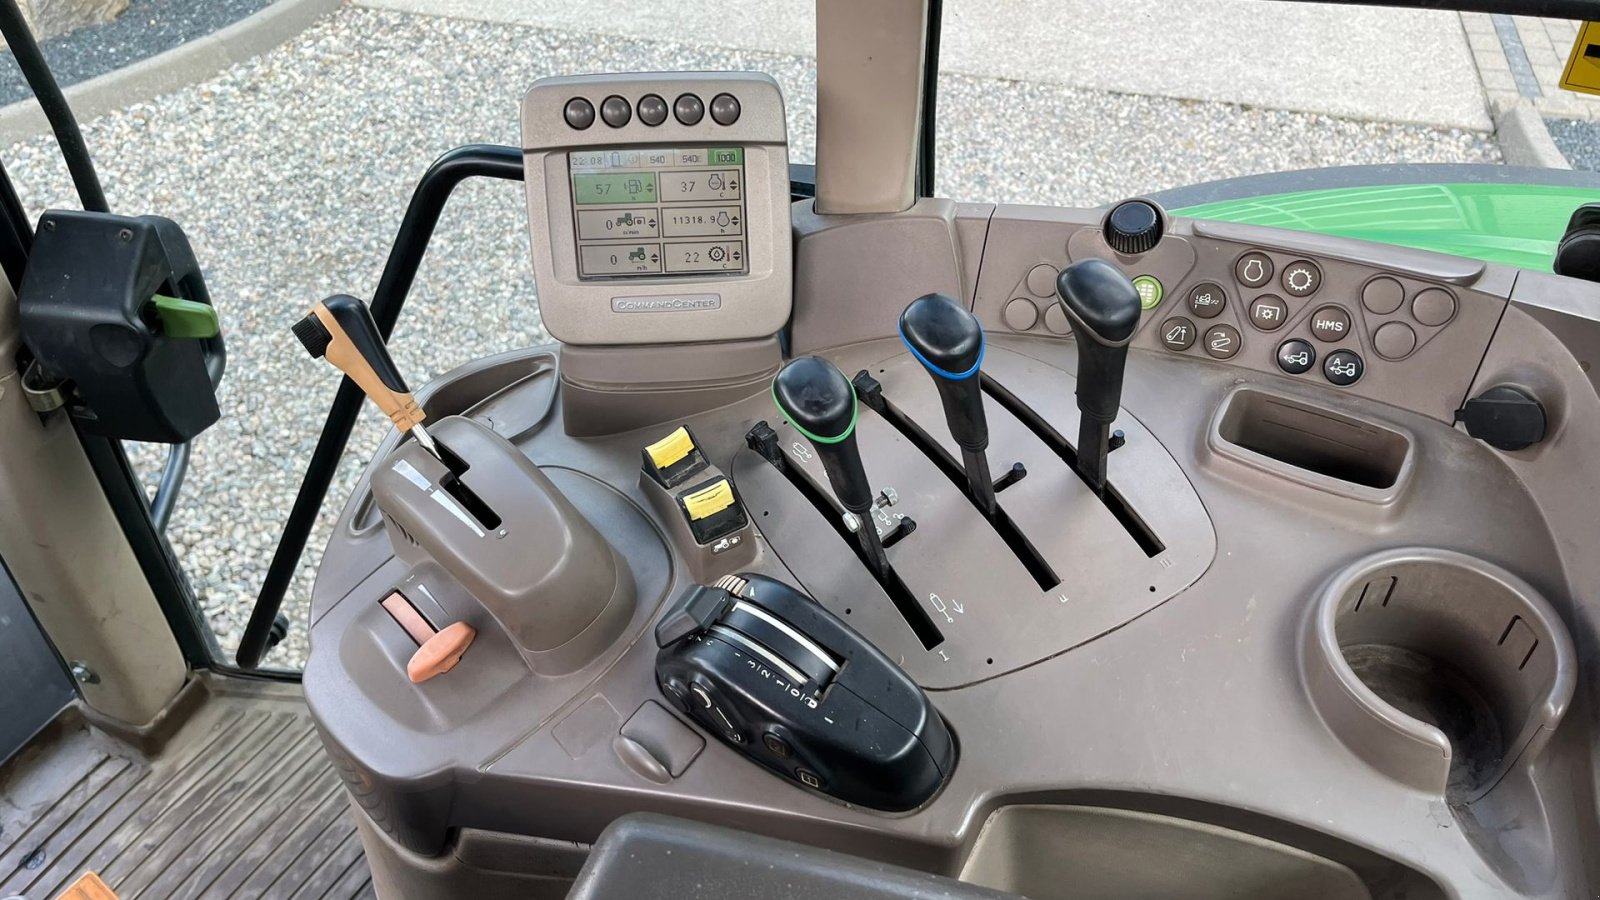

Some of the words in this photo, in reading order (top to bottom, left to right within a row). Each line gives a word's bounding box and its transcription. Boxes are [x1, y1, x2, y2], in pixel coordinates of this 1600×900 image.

[649, 155, 665, 164] 540
[595, 183, 612, 195] 57
[680, 181, 696, 193] 37
[605, 219, 613, 231] 0
[673, 215, 716, 225] 11318.9
[610, 254, 618, 266] 0
[684, 251, 700, 263] 22
[1316, 319, 1344, 332] HMS
[1333, 357, 1341, 366] A
[747, 659, 756, 669] 3
[761, 668, 771, 679] 2
[776, 679, 785, 687] 1
